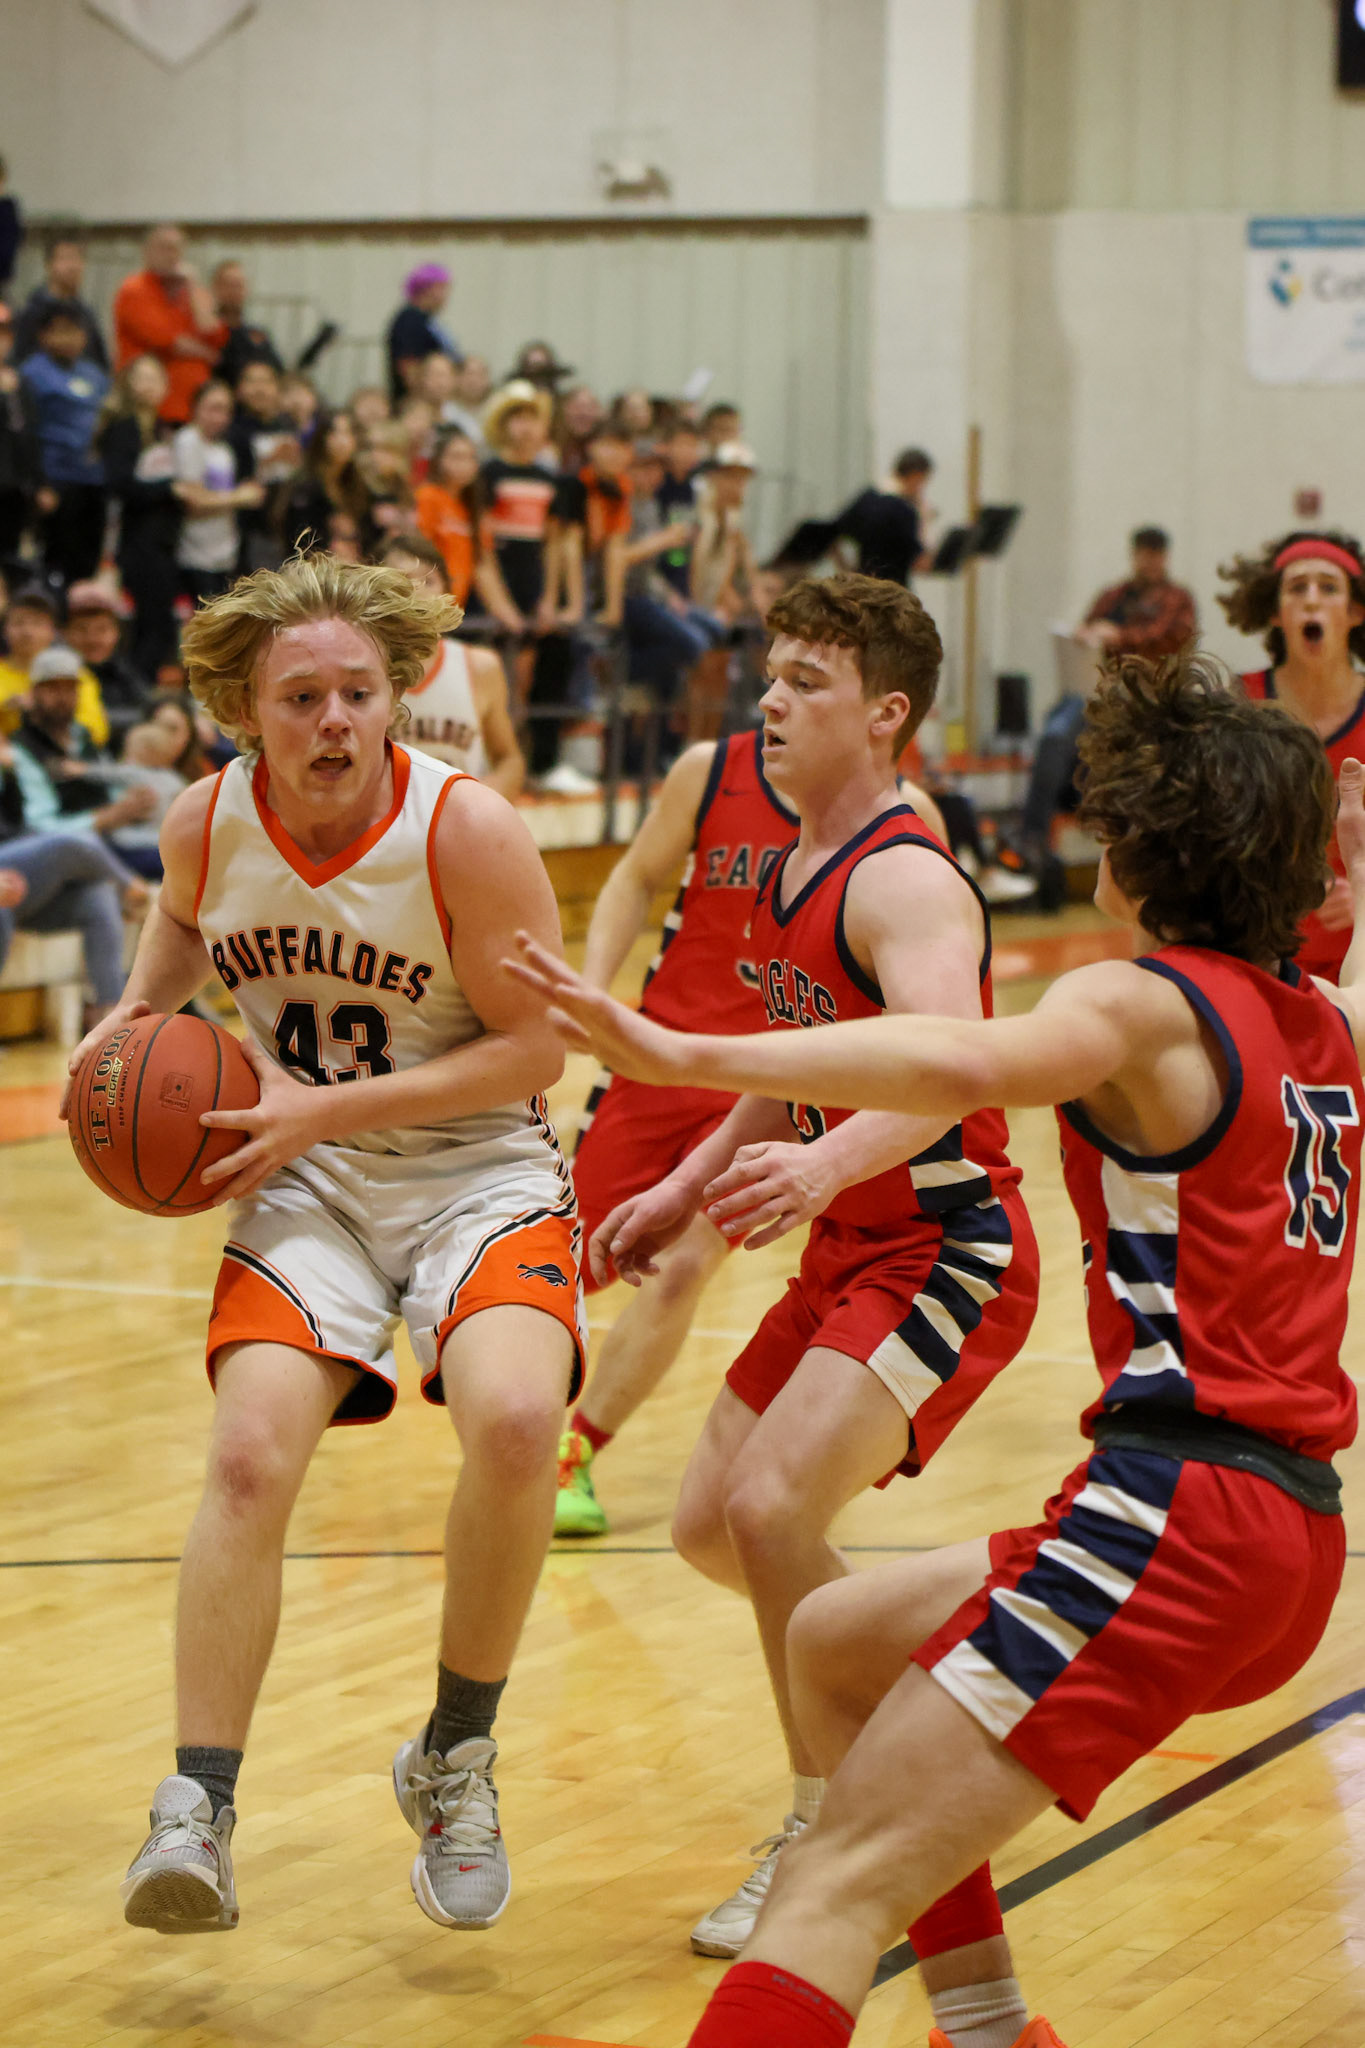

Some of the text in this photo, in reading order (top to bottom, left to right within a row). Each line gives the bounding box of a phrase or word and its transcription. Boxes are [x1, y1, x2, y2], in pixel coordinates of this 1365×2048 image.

[210, 925, 434, 1005] BUFFALOES
[91, 1028, 132, 1152] TF-1000
[272, 998, 397, 1086] 43
[1280, 1073, 1361, 1258] 15
